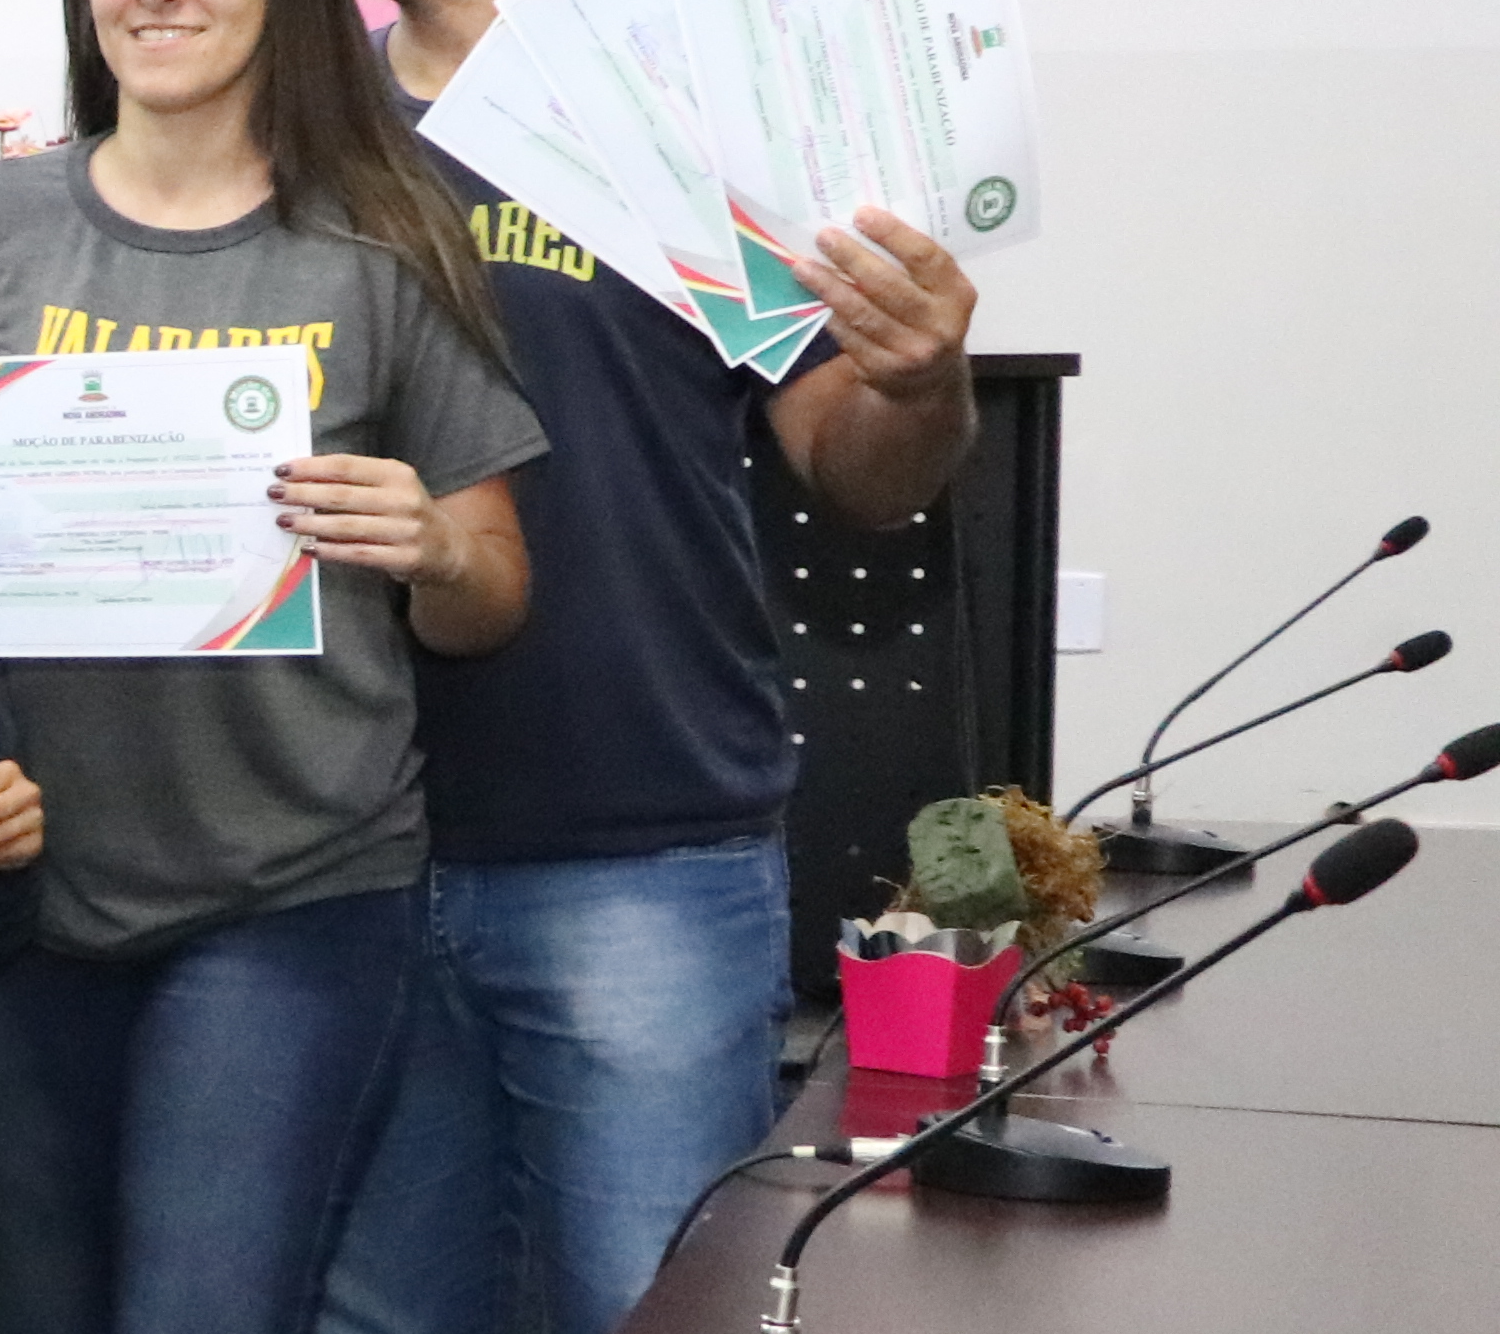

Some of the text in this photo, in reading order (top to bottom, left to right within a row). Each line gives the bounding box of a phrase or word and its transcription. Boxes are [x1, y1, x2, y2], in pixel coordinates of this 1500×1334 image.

[917, 16, 931, 33] DE
[923, 35, 956, 147] PARABENIZAÇÃO
[12, 432, 186, 449] MOÇÃO DE PARABENIZAÇÃO
